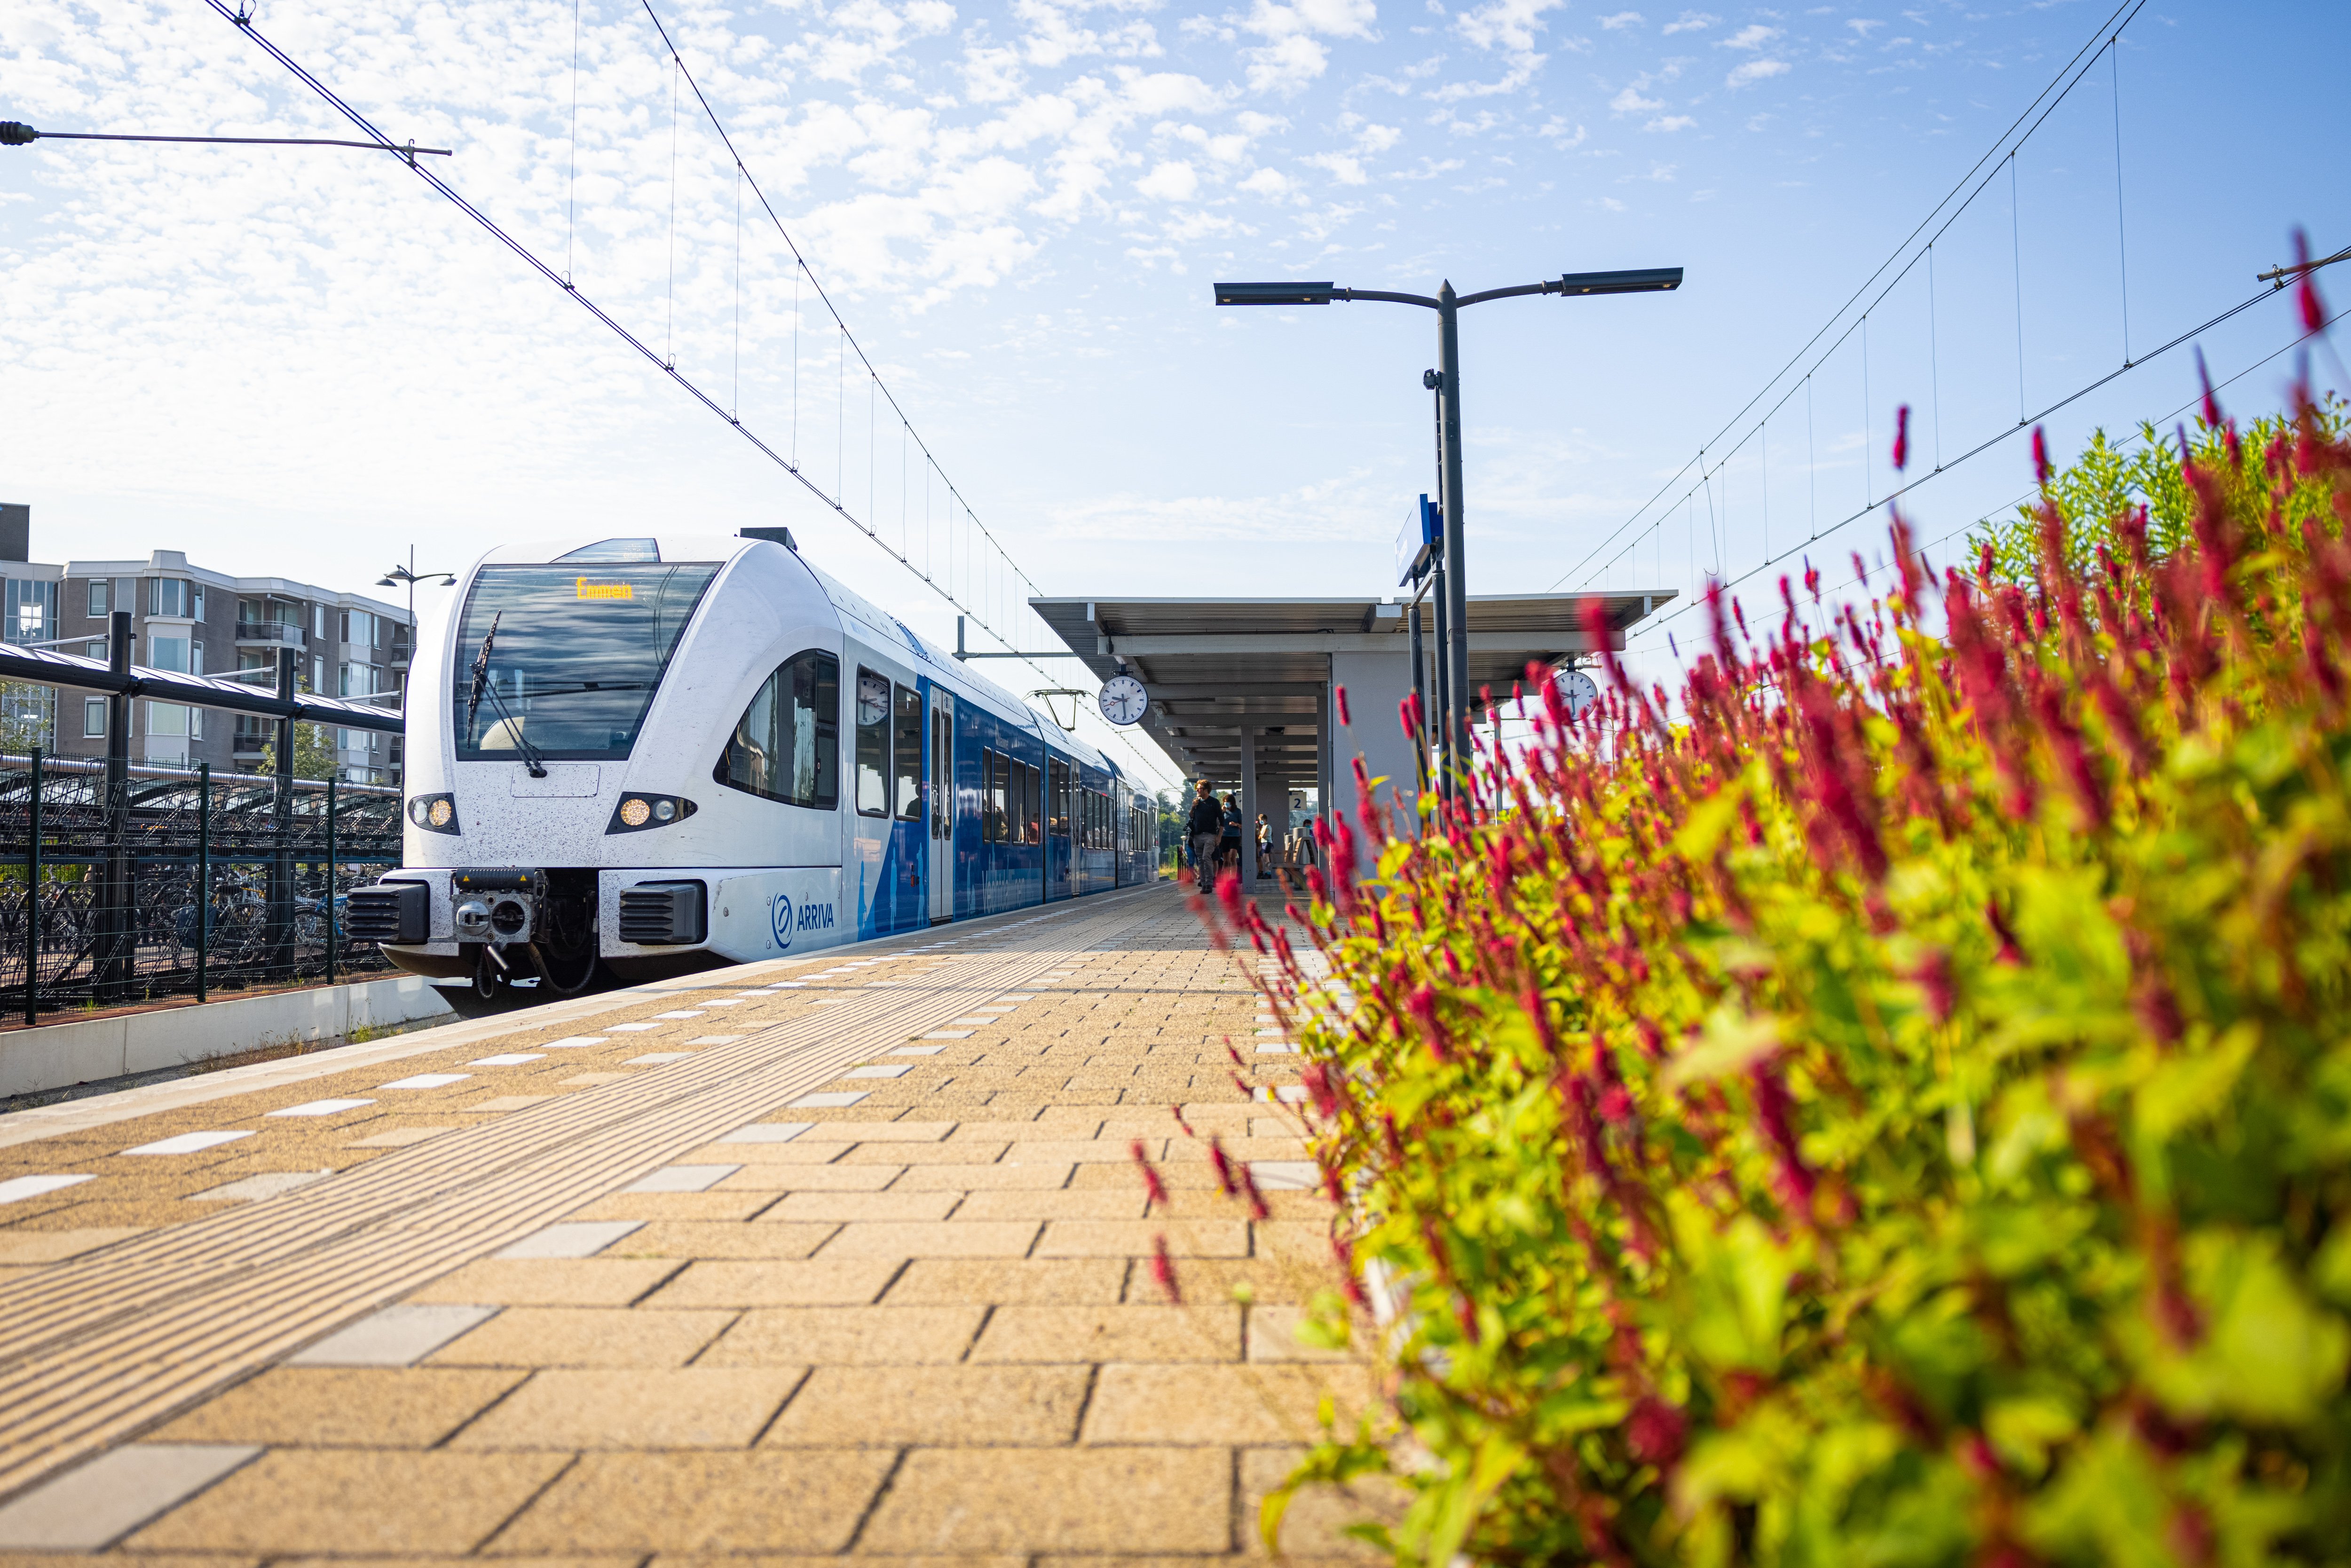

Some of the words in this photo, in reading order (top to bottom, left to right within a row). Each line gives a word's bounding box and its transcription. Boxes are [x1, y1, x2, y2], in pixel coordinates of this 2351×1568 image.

[576, 576, 632, 599] Emmen
[1294, 798, 1301, 808] 2
[797, 903, 834, 931] ARRIVA
